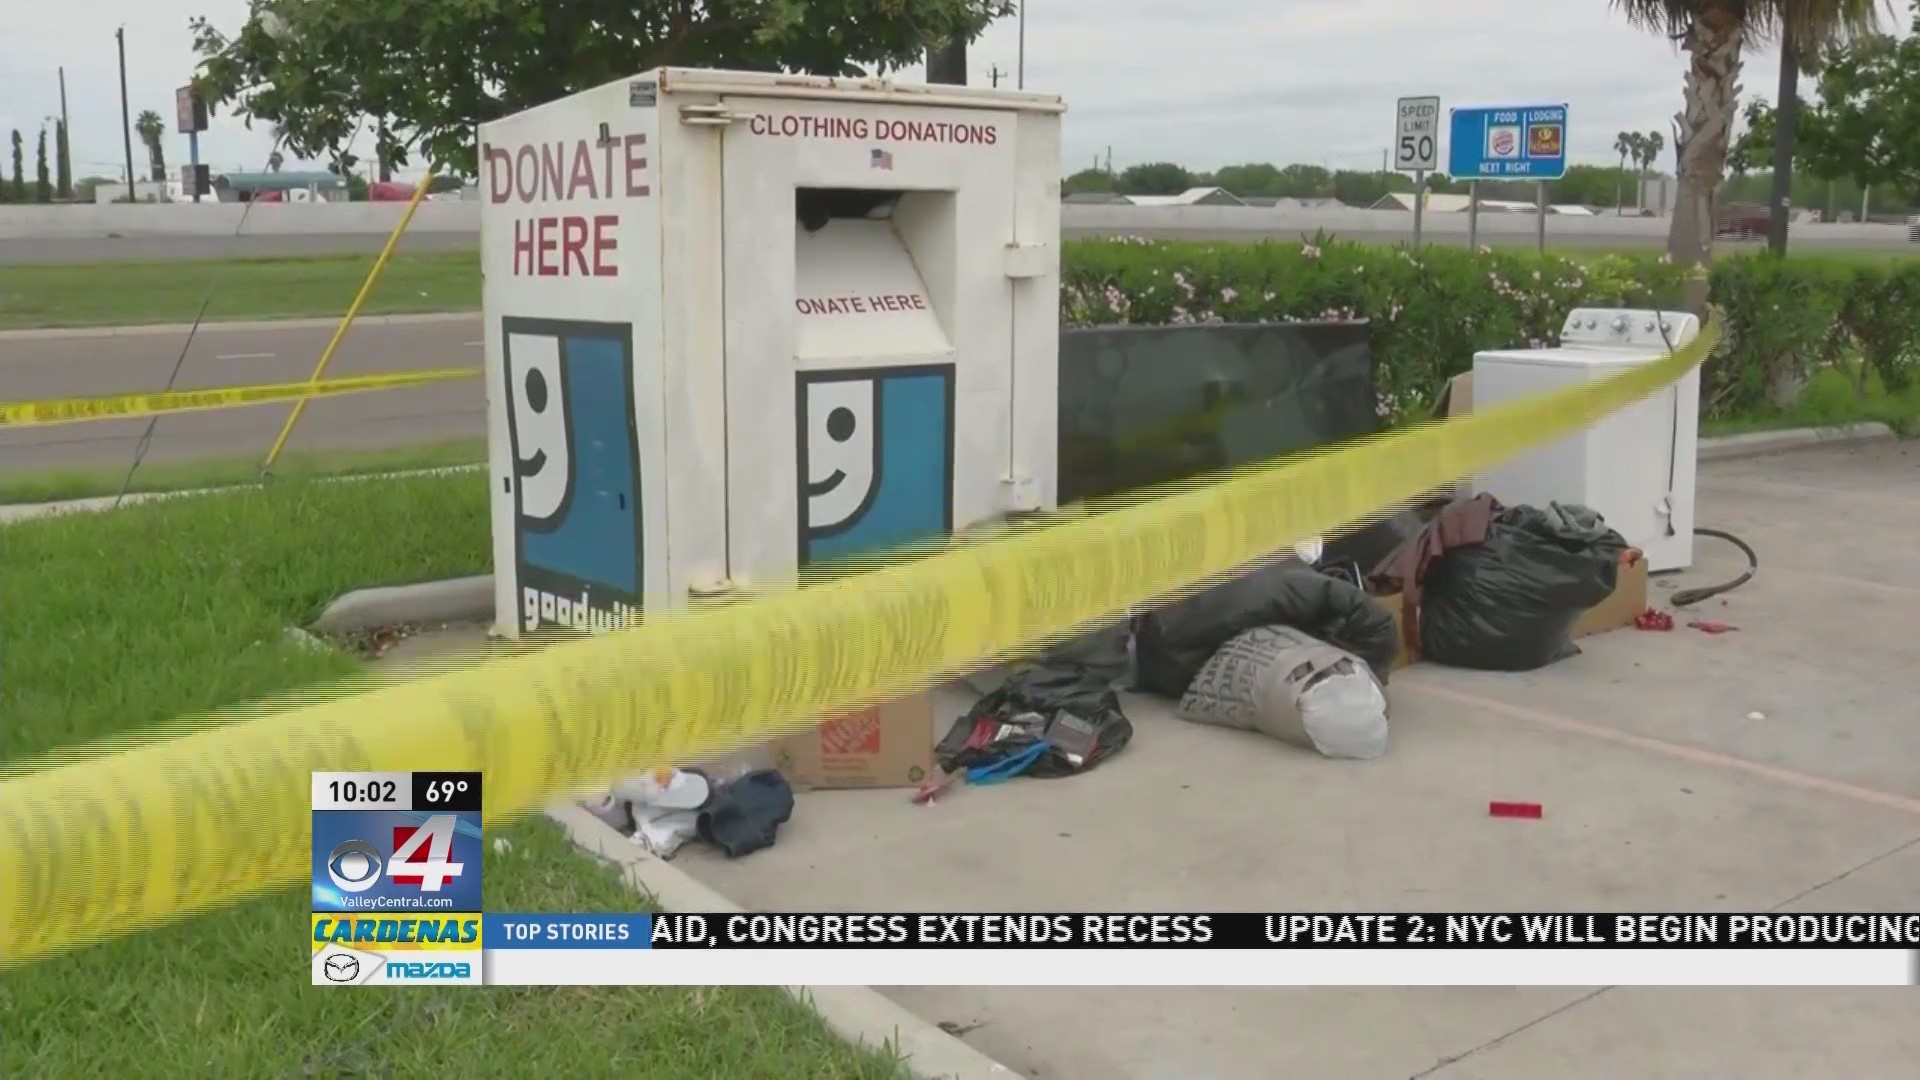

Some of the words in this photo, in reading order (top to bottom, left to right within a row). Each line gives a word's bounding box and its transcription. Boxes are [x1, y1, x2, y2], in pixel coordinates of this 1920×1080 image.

[1401, 104, 1434, 118] SPEED
[1494, 112, 1517, 122] FOOD
[1529, 110, 1563, 121] LODGING
[751, 114, 868, 139] CLOTHING
[875, 120, 997, 145] DONATIONS
[1404, 120, 1430, 133] LIMIT
[1400, 136, 1433, 162] 50
[490, 133, 650, 205] DONATE
[1479, 162, 1499, 173] NEXT
[1506, 162, 1531, 173] RIGHT
[513, 214, 620, 277] HERE
[868, 294, 927, 312] HERE
